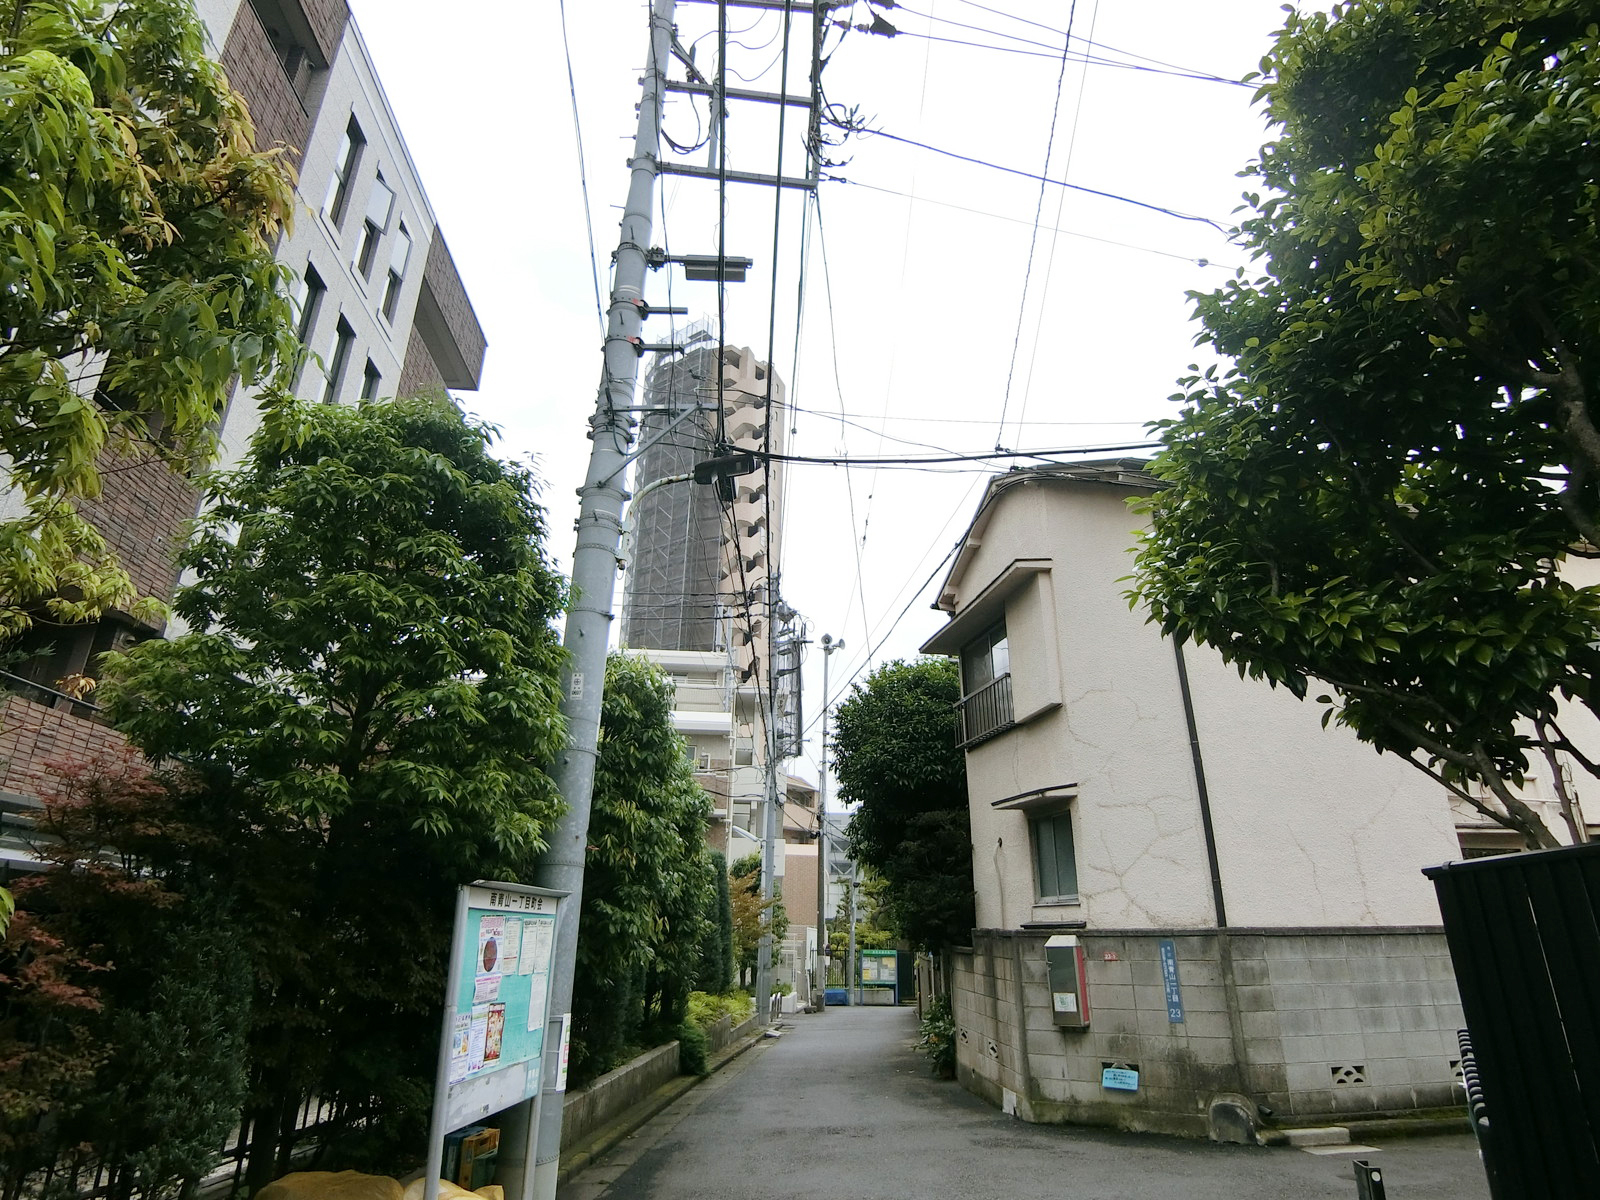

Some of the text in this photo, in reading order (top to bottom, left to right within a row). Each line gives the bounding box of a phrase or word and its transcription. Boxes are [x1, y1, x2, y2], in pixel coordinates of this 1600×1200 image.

[490, 892, 543, 910] 南青山一丁目町会
[1167, 959, 1179, 1002] 南青山一丁目
[1170, 1008, 1181, 1018] 23
